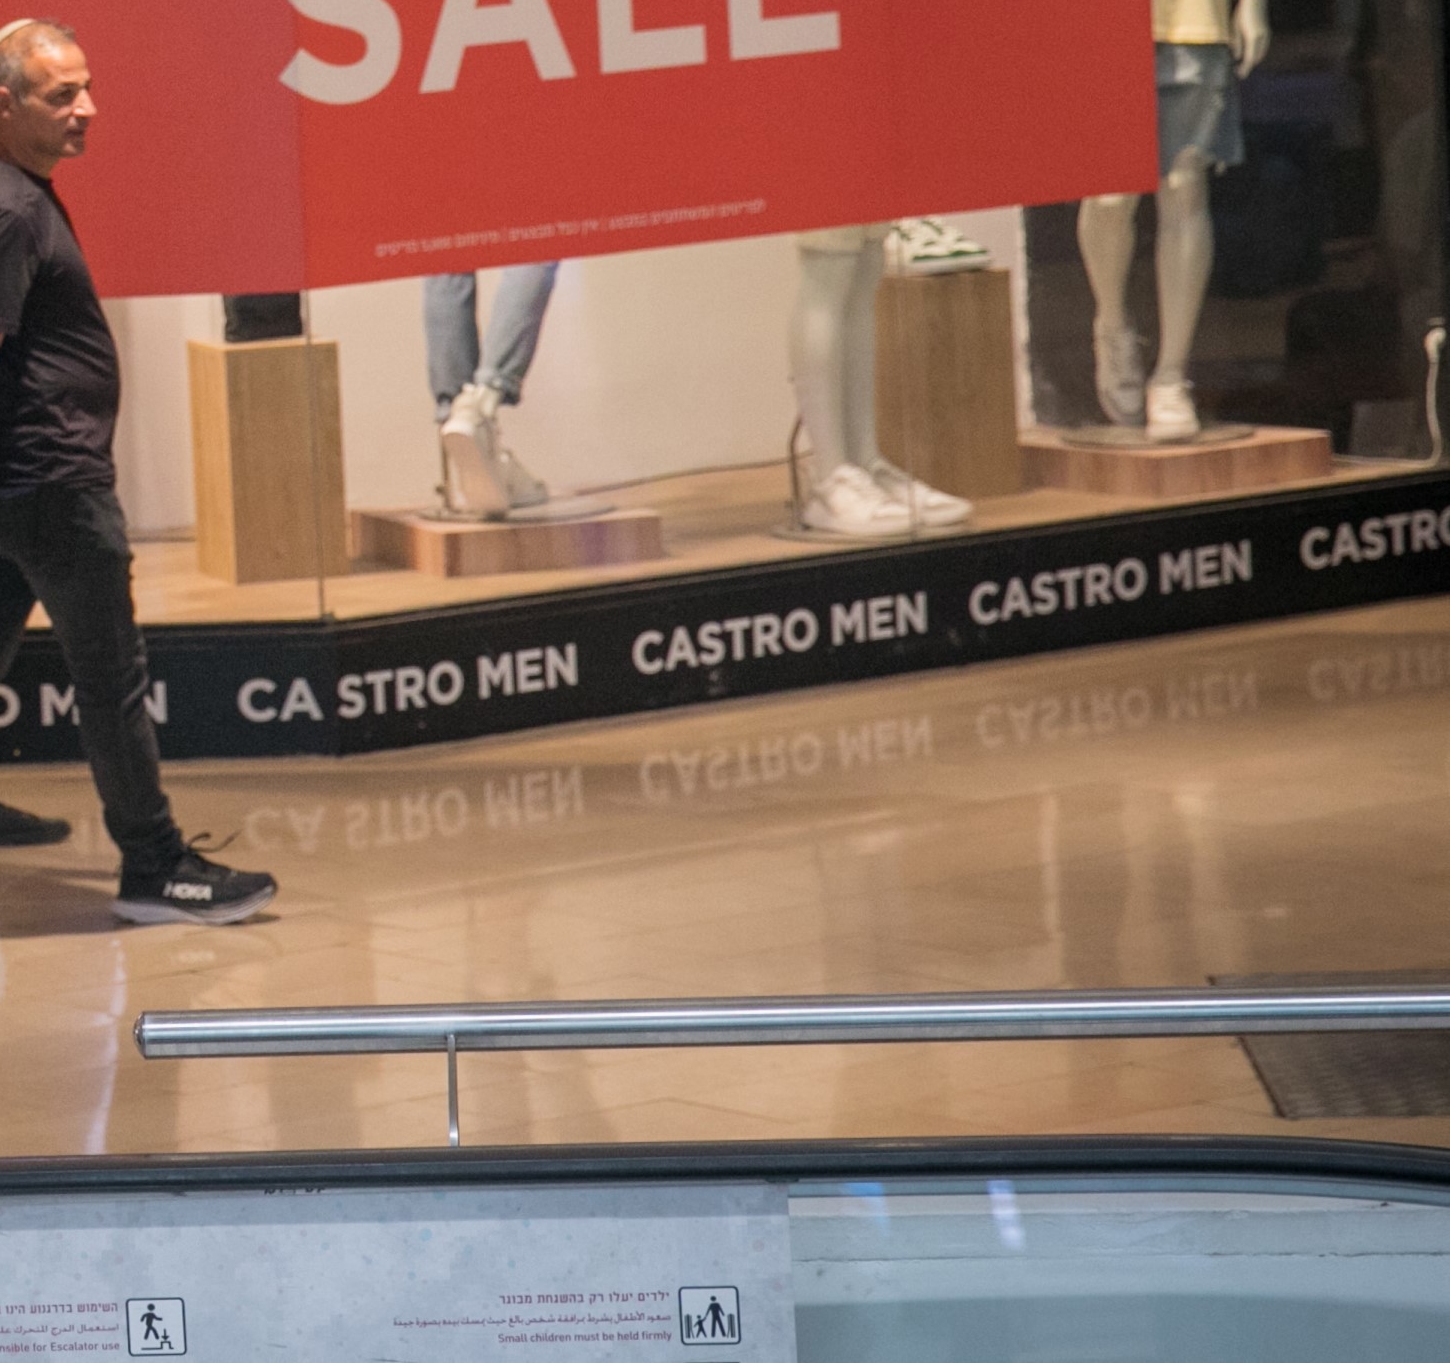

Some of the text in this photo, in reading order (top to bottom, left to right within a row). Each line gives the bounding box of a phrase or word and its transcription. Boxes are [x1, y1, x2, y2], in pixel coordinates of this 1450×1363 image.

[968, 539, 1254, 626] CASTRO MEN
[631, 591, 929, 677] CASTRO MEN
[476, 642, 580, 700] MEN
[40, 681, 169, 726] MN
[499, 1290, 670, 1305] ילדים יעלו רק בהשגחת מבוגר
[5, 1304, 26, 1314] הינו
[77, 1302, 119, 1313] השימוש
[497, 1330, 673, 1343] Small children must be held firmly
[32, 1342, 47, 1352] for
[50, 1341, 99, 1352] Escalator
[101, 1343, 120, 1351] use
